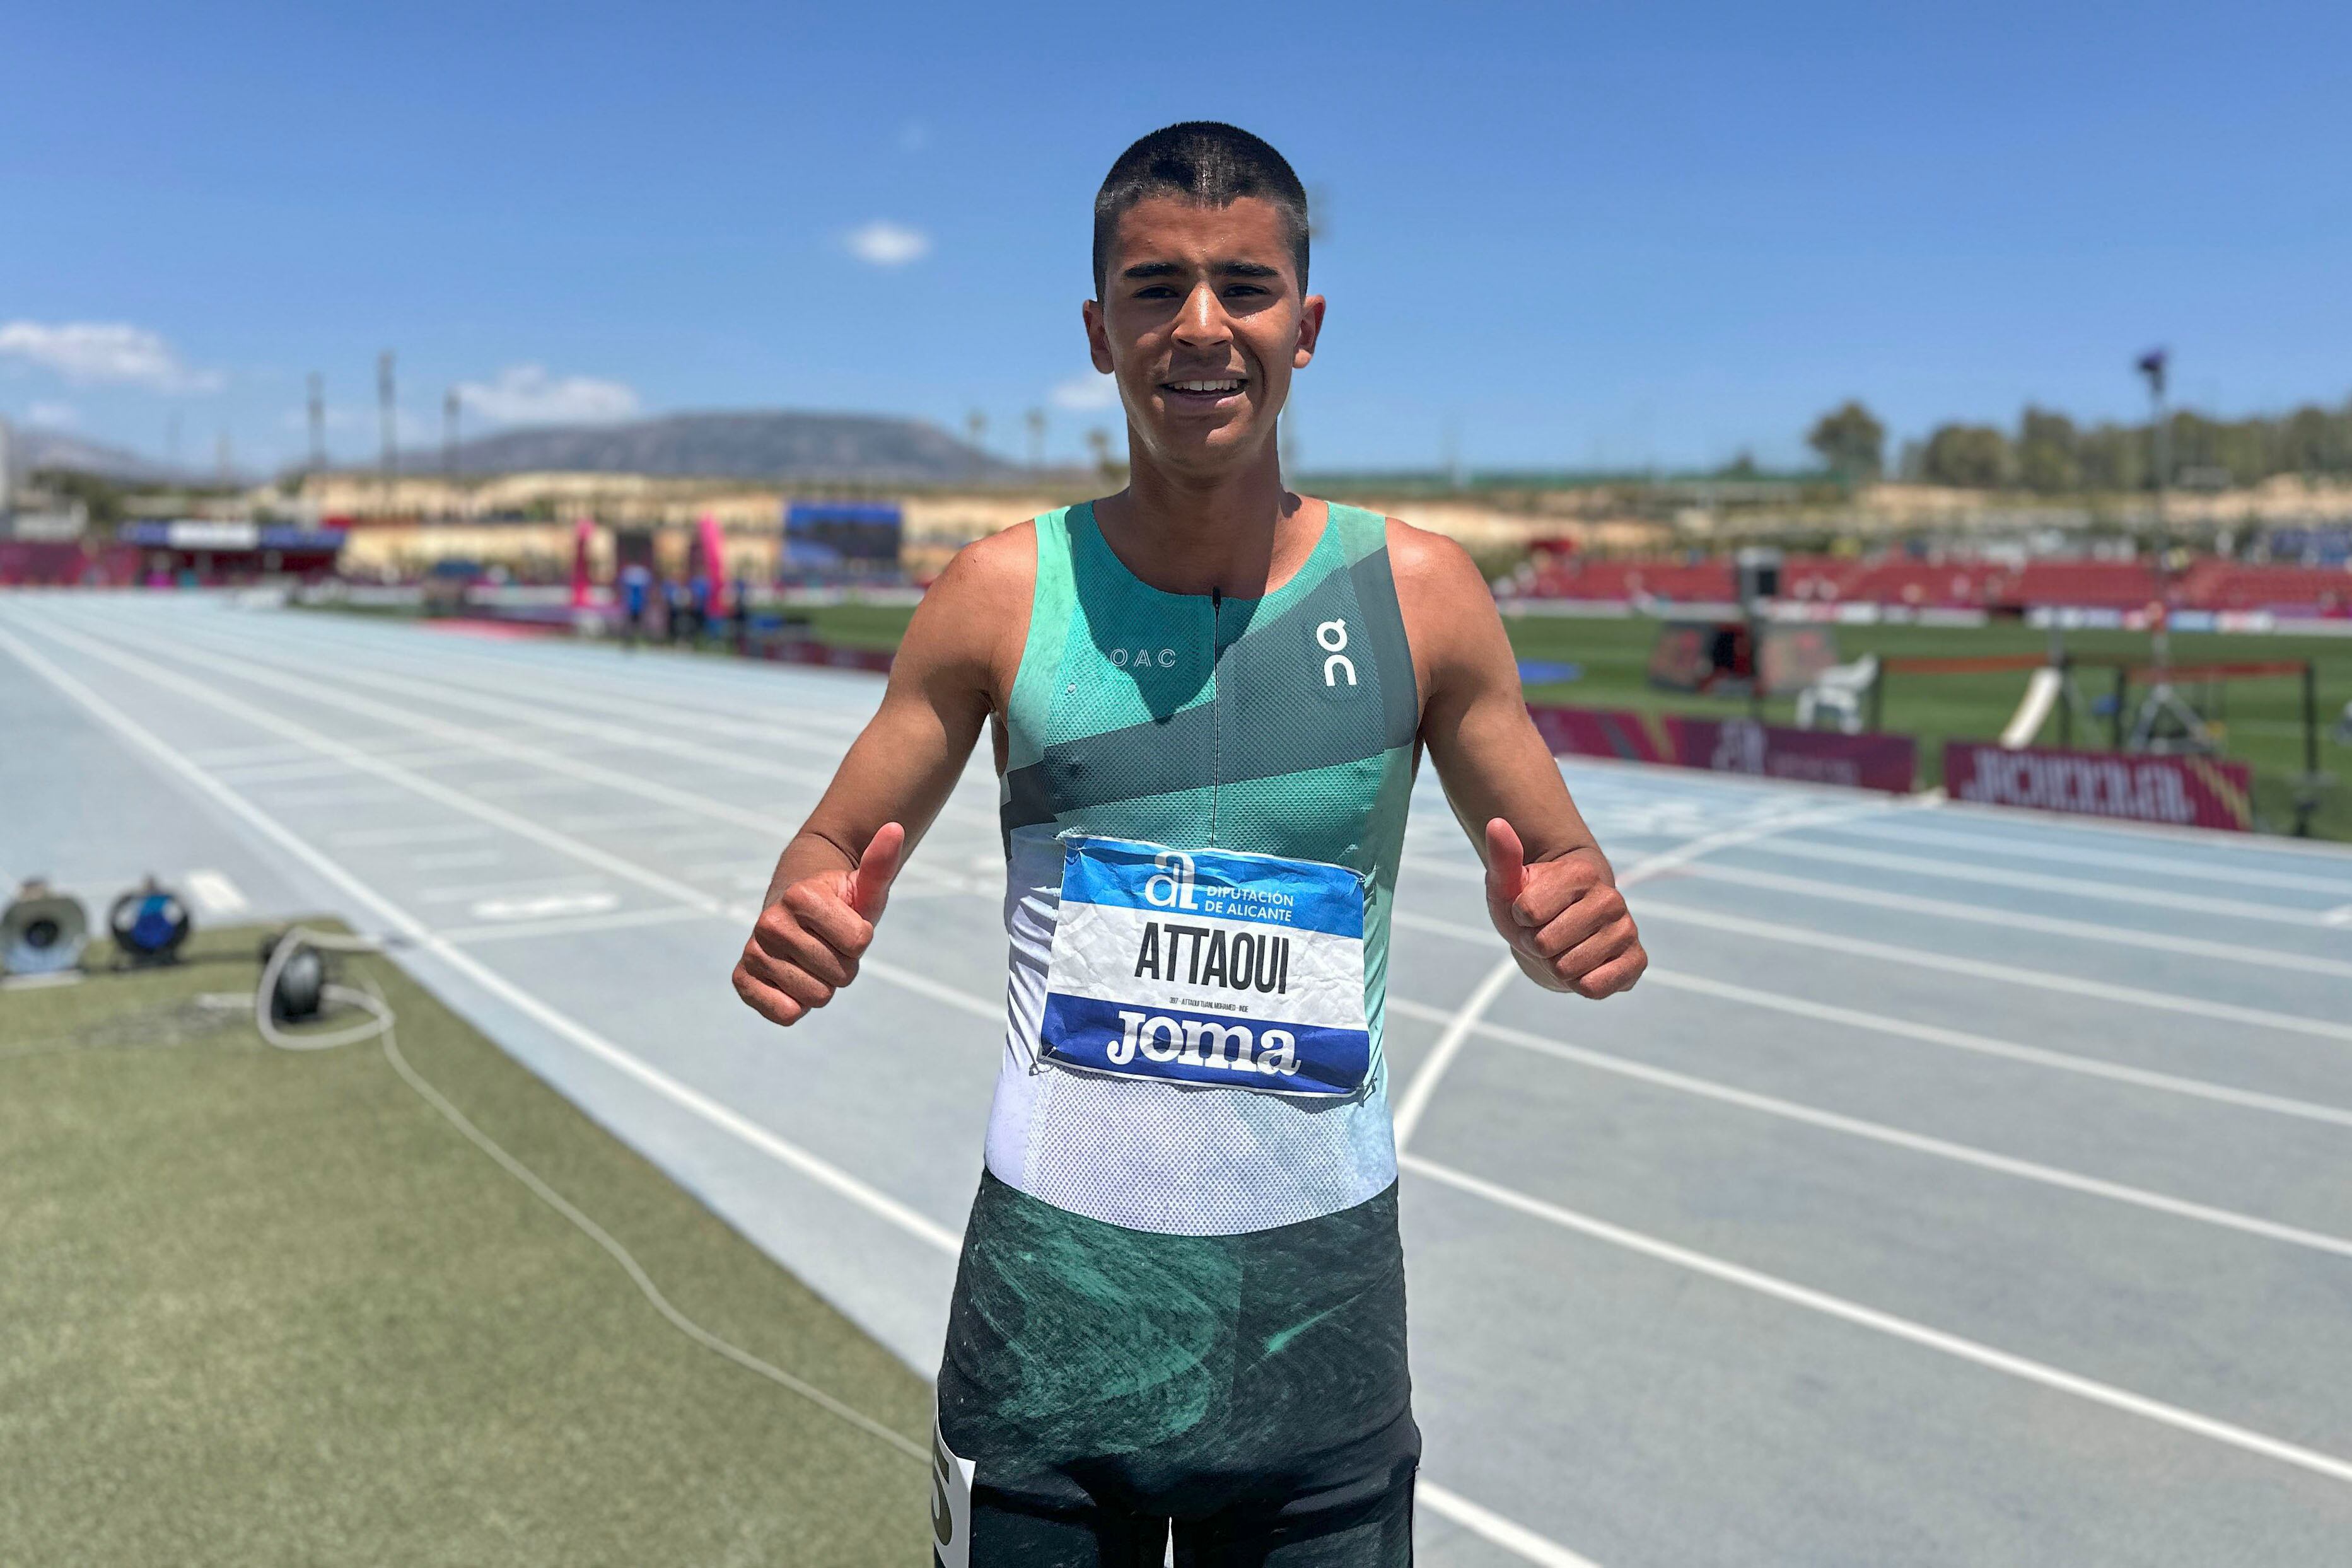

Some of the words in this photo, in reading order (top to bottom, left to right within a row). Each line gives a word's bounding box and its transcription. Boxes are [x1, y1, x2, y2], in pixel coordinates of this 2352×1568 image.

[1110, 648, 1177, 668] OAC
[1207, 885, 1293, 907] DIPUTACIÓN
[1205, 900, 1223, 914] DE
[1226, 904, 1292, 922] ALICANTE
[1134, 922, 1290, 994] ATTAOUI
